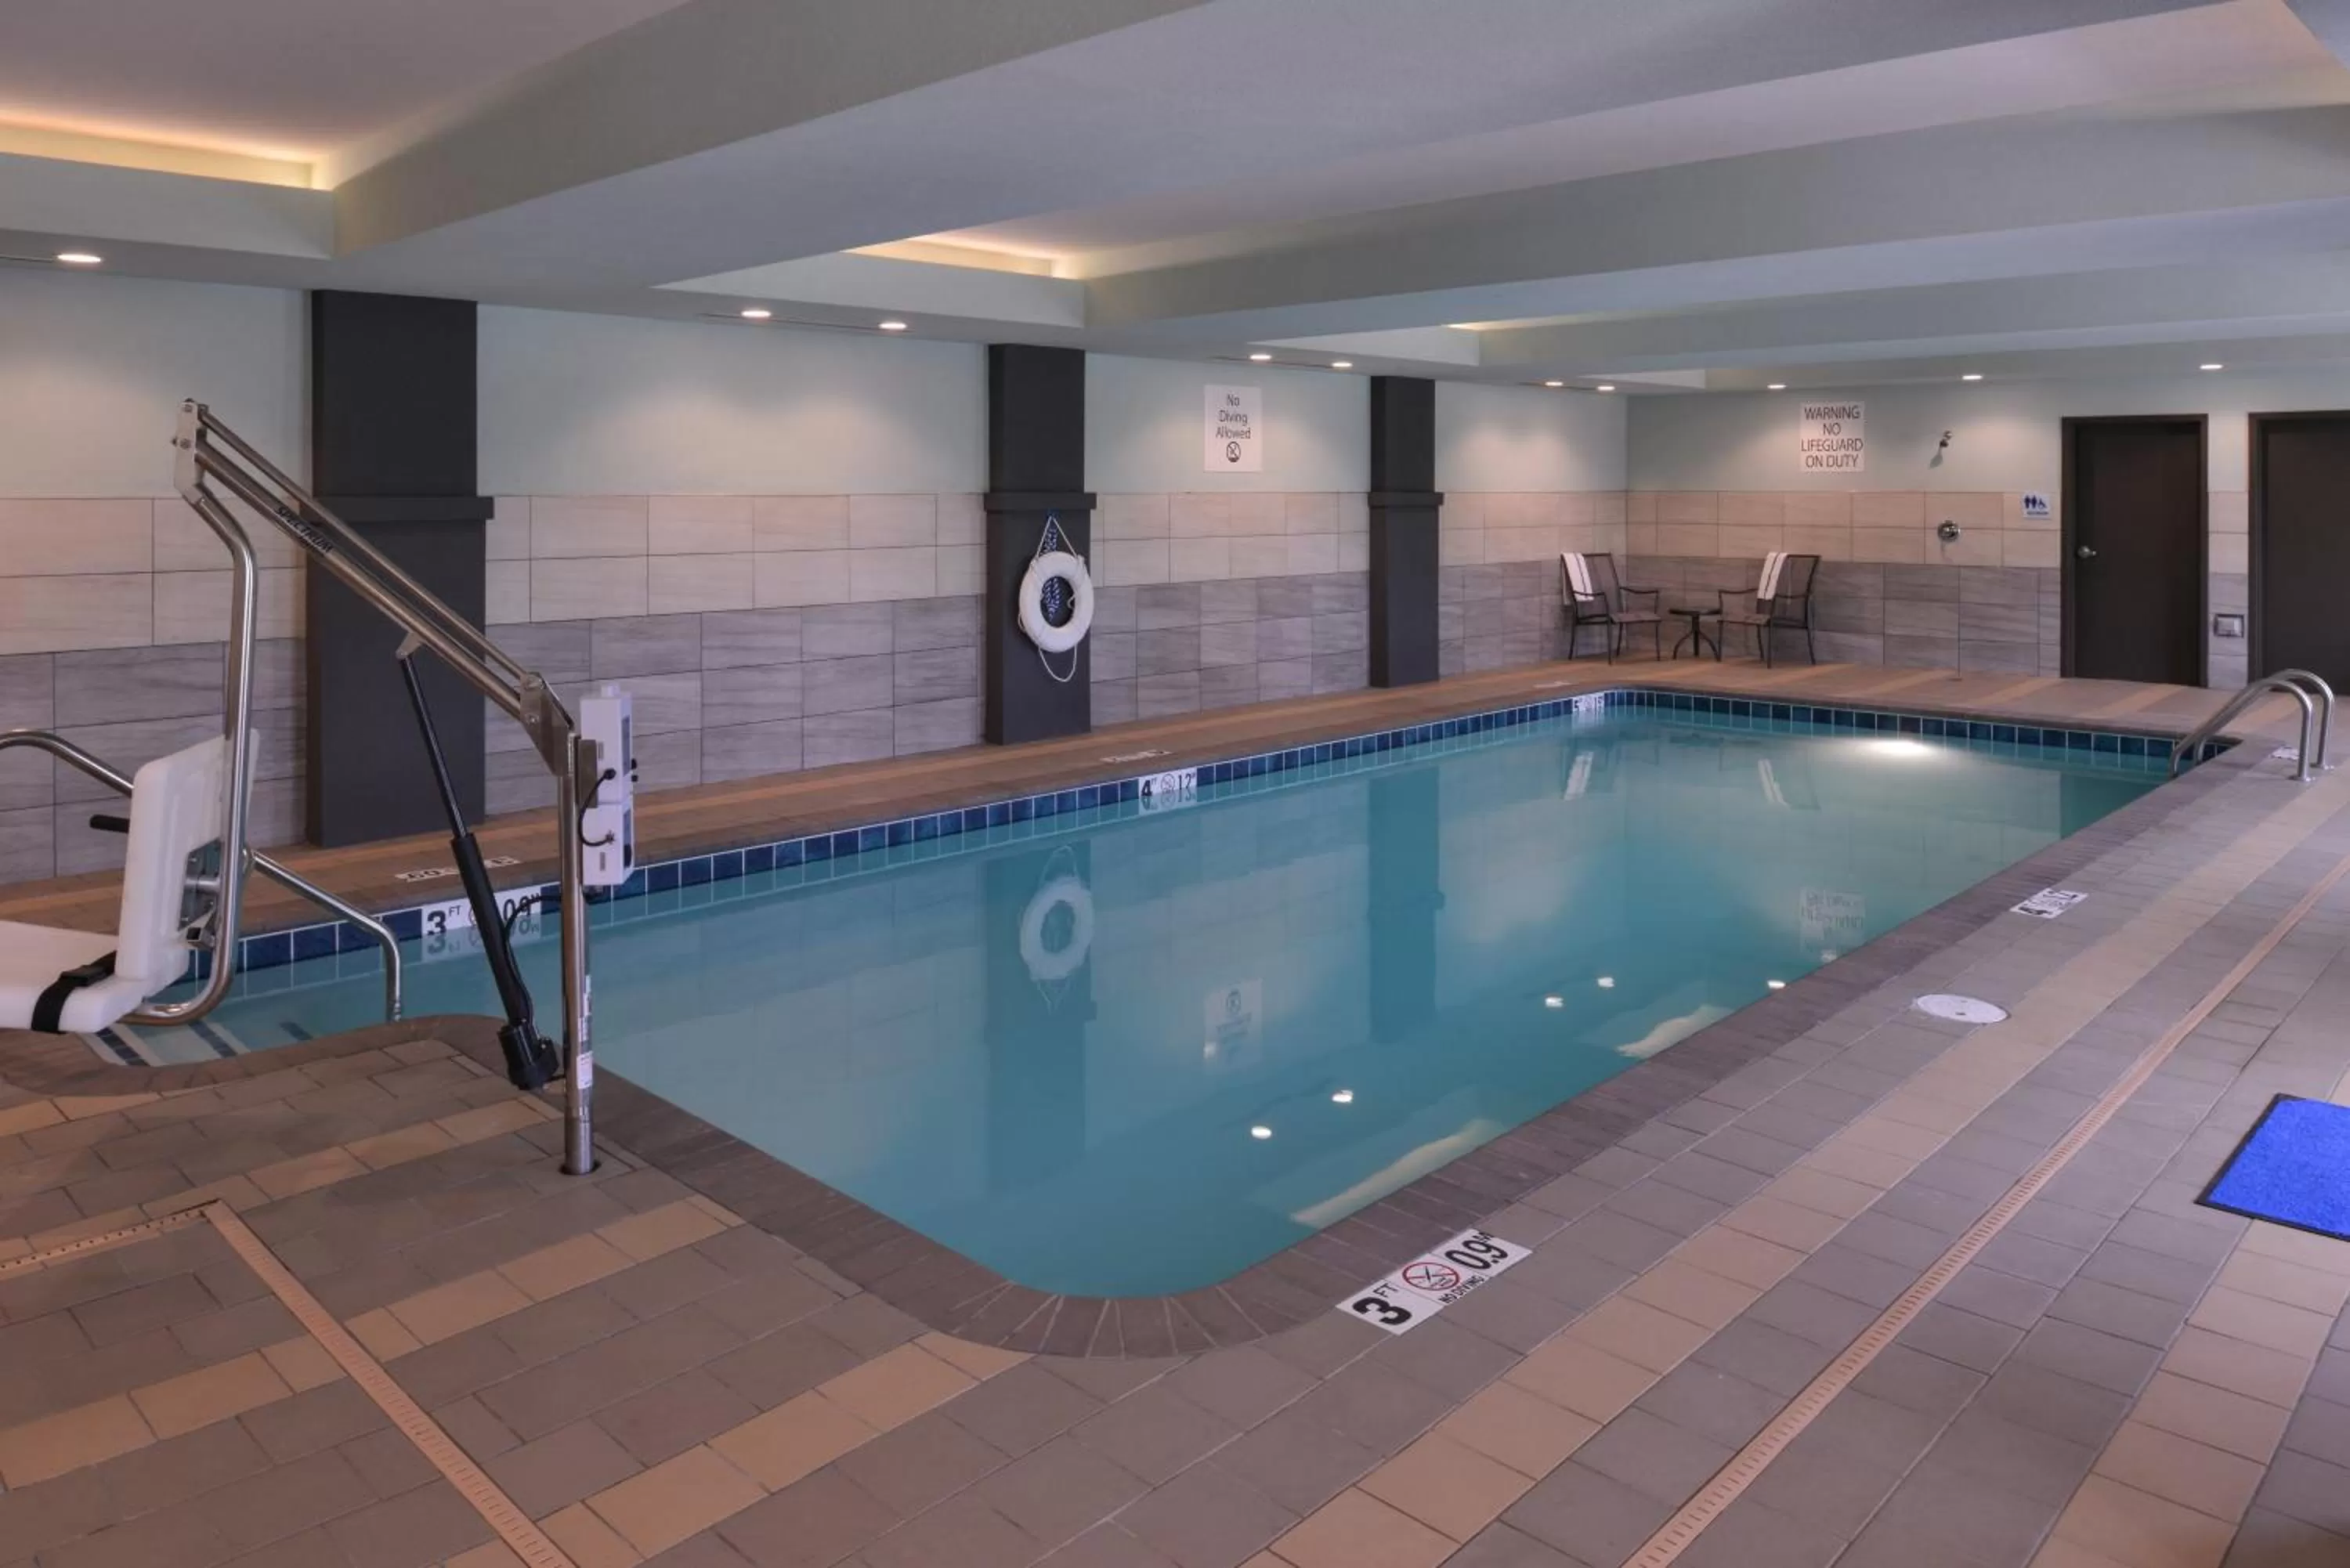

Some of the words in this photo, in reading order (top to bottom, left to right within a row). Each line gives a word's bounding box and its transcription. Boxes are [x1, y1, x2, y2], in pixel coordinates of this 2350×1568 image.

[1227, 394, 1240, 406] No
[1219, 410, 1248, 426] Diving
[1804, 405, 1860, 420] WARNING
[1823, 423, 1842, 436] NO
[1801, 438, 1864, 452] LIFEGUARD
[1806, 455, 1824, 468] ON
[1826, 453, 1859, 468] DUTY
[1141, 779, 1152, 797] 4
[427, 909, 446, 936] 3
[448, 905, 461, 916] FT
[1444, 1240, 1509, 1270] 0.9
[1372, 1283, 1399, 1299] FT
[1352, 1296, 1412, 1325] 3
